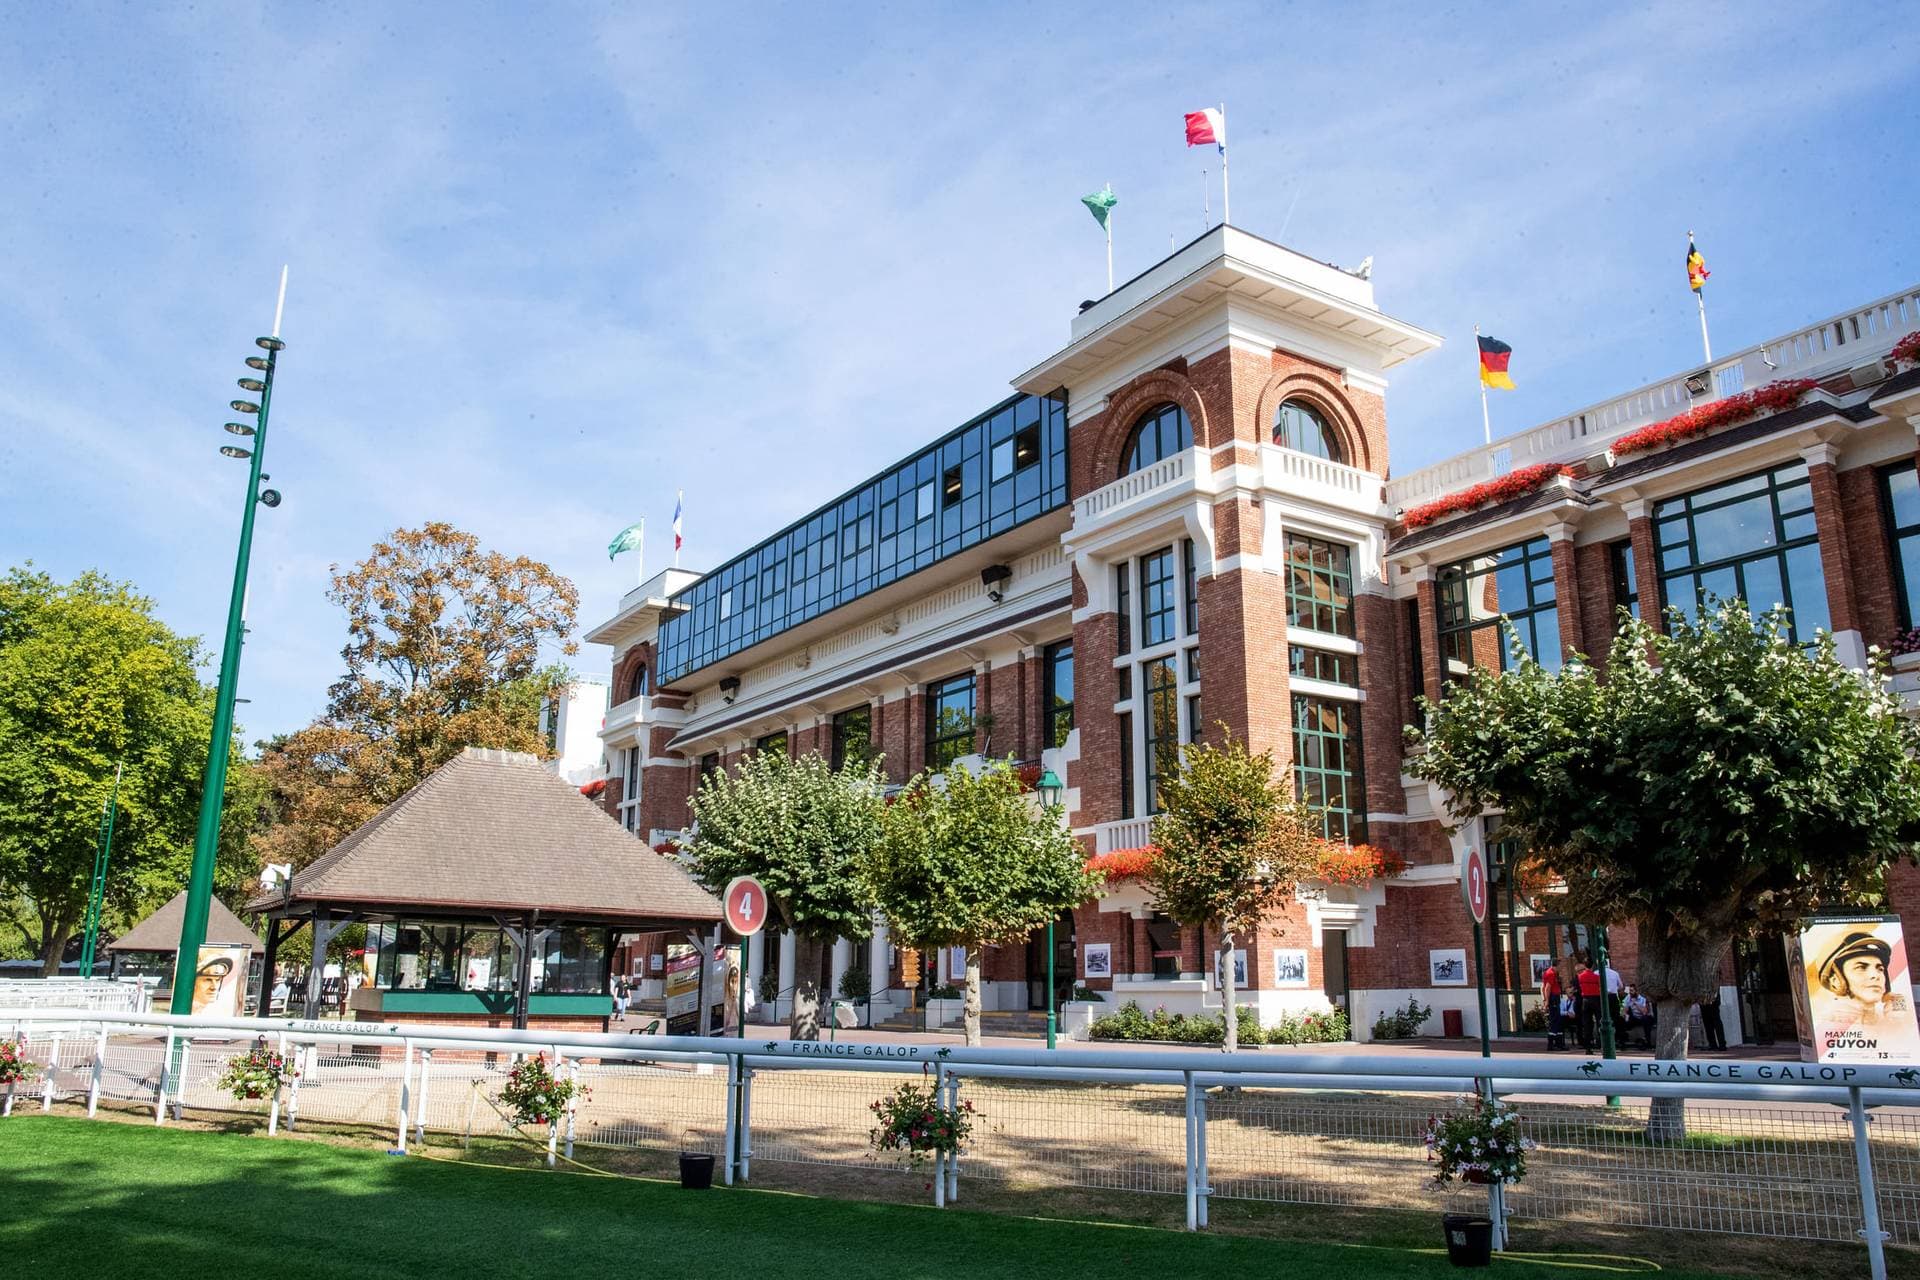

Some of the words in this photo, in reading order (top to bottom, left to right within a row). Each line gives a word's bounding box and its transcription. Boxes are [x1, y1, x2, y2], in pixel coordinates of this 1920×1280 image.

[1472, 866, 1481, 904] 2
[739, 892, 752, 921] 4
[303, 1022, 341, 1031] FRANCE
[345, 1024, 379, 1033] GALOP
[792, 1043, 856, 1055] FRANCE
[863, 1045, 919, 1057] GALOP
[1826, 1039, 1878, 1049] GUYON
[1878, 1051, 1889, 1059] 13
[1629, 1063, 1741, 1078] FRANCE
[1757, 1065, 1858, 1081] GALOP
